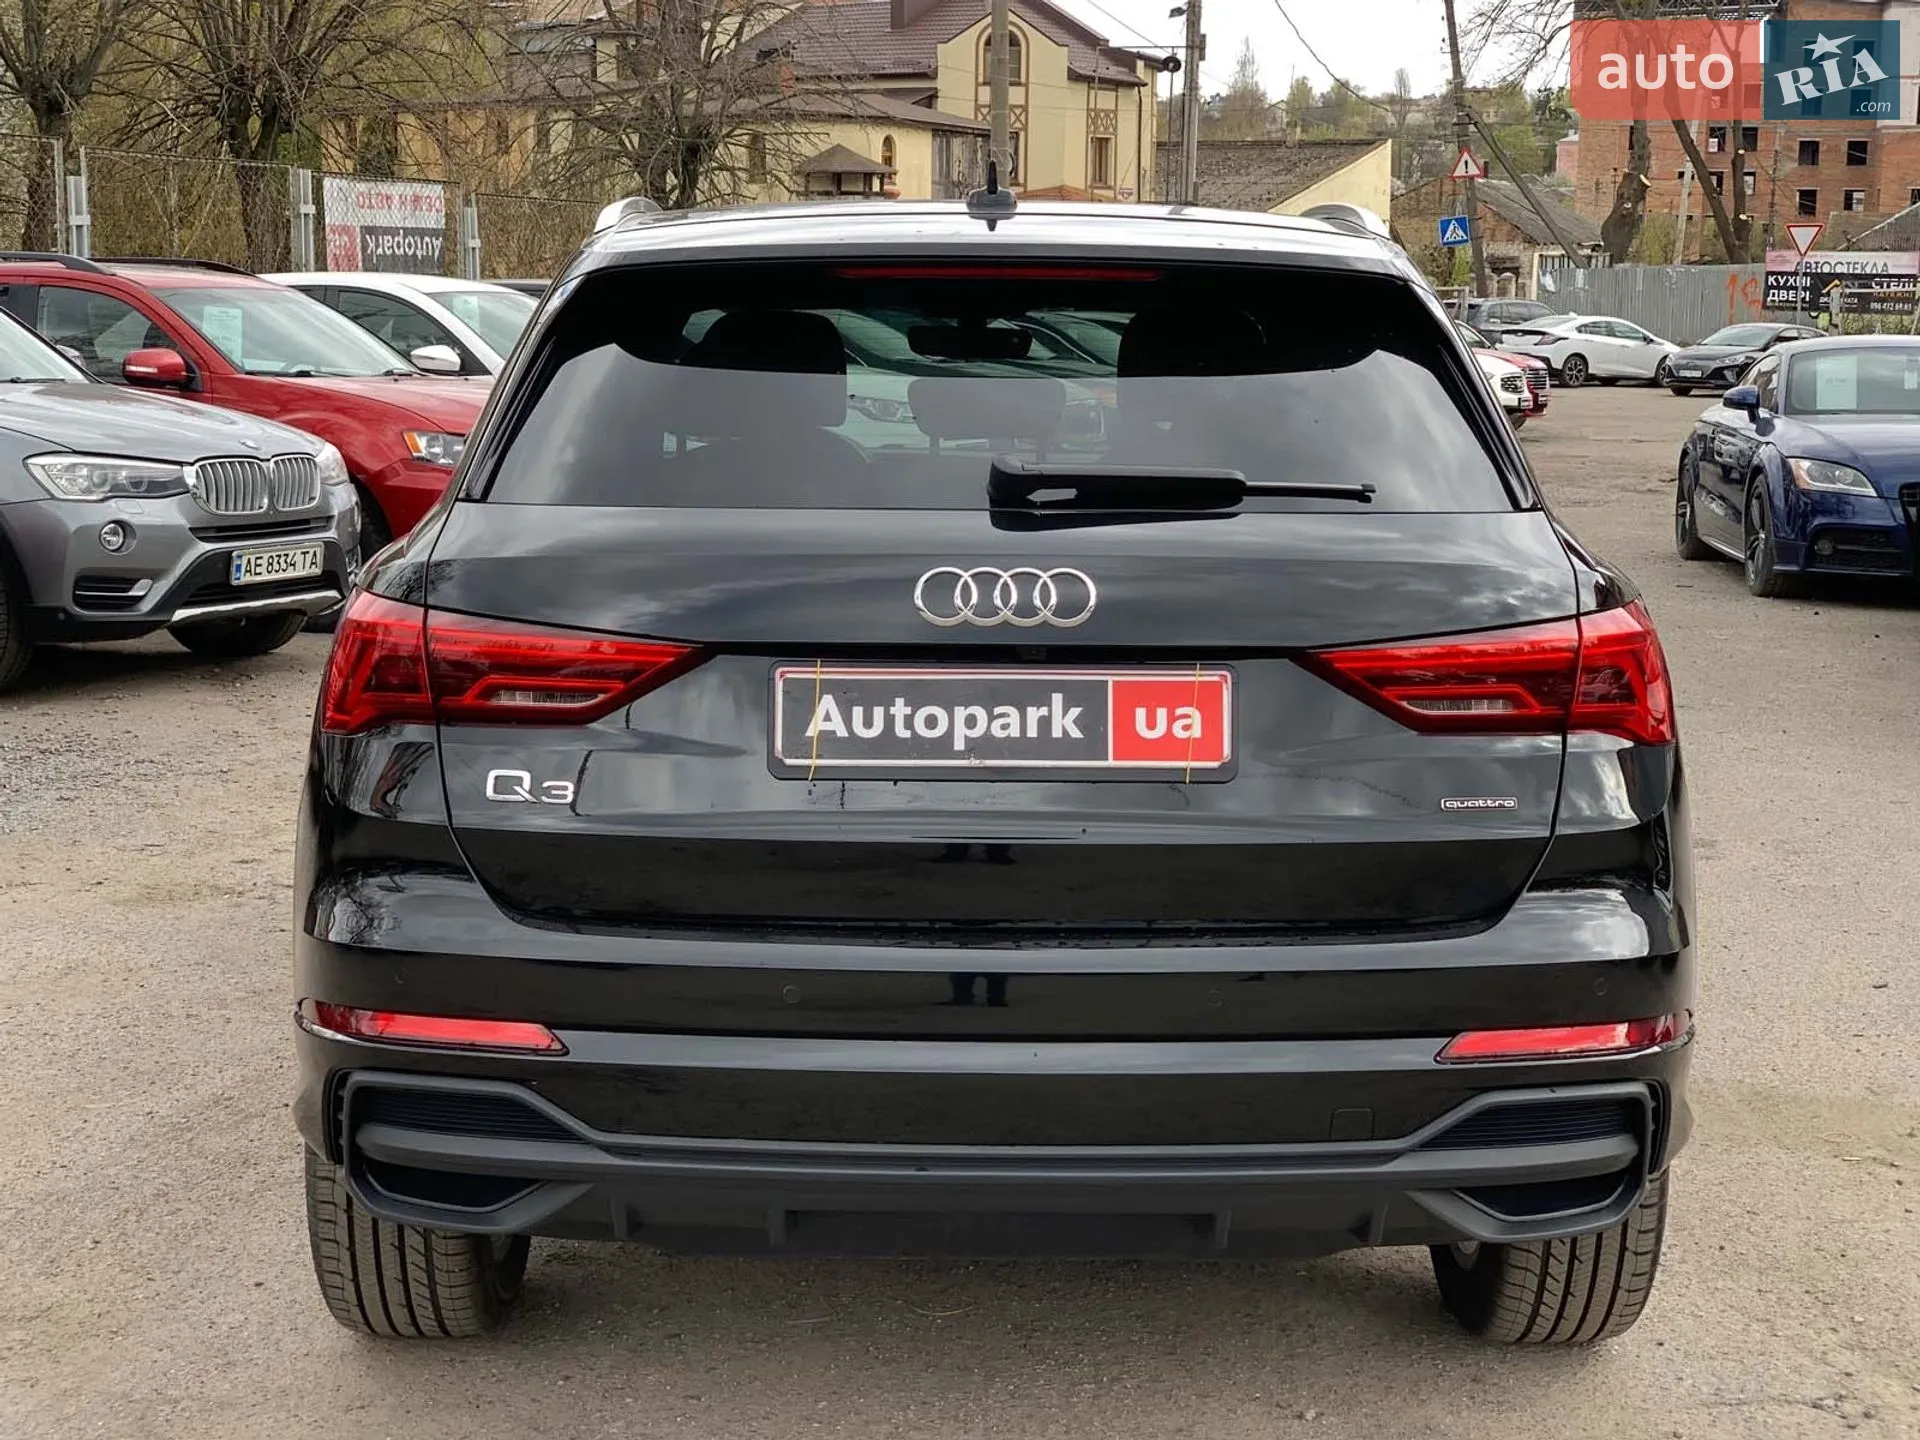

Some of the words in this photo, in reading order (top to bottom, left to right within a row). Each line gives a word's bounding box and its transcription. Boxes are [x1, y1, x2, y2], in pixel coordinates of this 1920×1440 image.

[365, 229, 443, 264] Autopark
[1795, 260, 1890, 273] АВТОСТЕКЛА
[1767, 275, 1811, 287] КУХНІ
[1766, 289, 1810, 302] ДВЕРІ
[244, 556, 263, 577] AE
[266, 552, 297, 574] 8334
[301, 549, 318, 570] TA
[805, 693, 1085, 751] Autopark
[1134, 704, 1202, 739] ua
[486, 769, 575, 804] Q3
[1445, 799, 1515, 809] quattro
